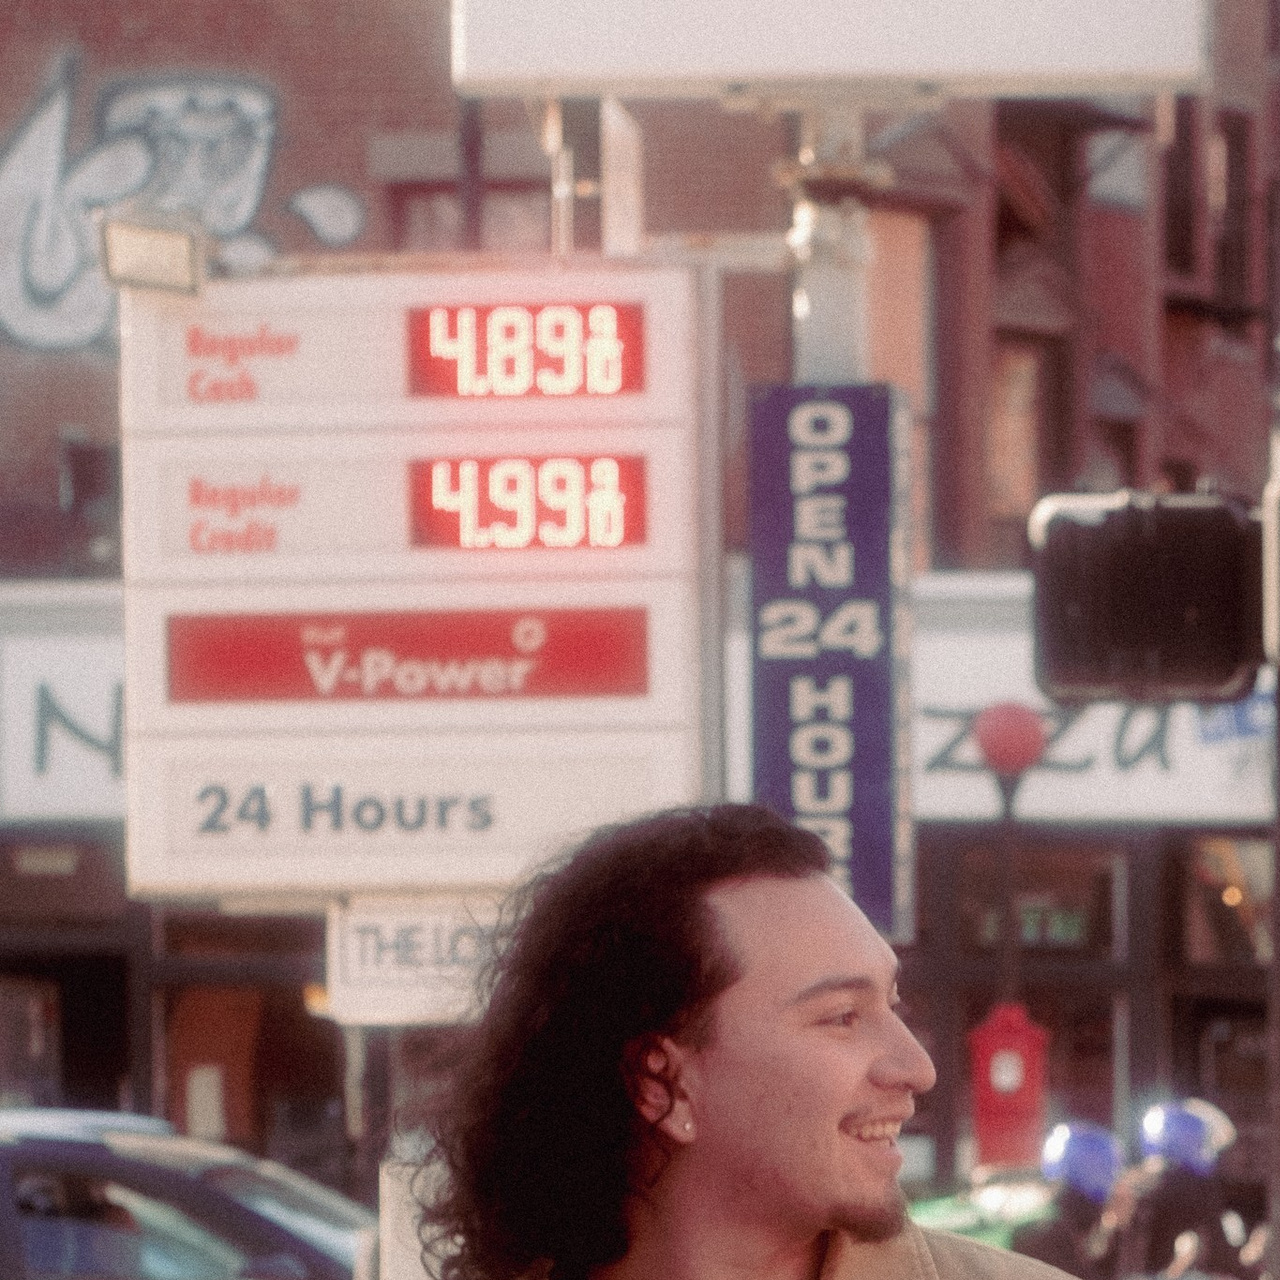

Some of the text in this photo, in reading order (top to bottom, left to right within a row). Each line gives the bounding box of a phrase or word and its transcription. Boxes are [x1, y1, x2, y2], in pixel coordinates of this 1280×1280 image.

[303, 646, 536, 696] V-Power
[758, 402, 883, 899] OPEN 24 HOUR
[198, 784, 496, 834] 24 Hours
